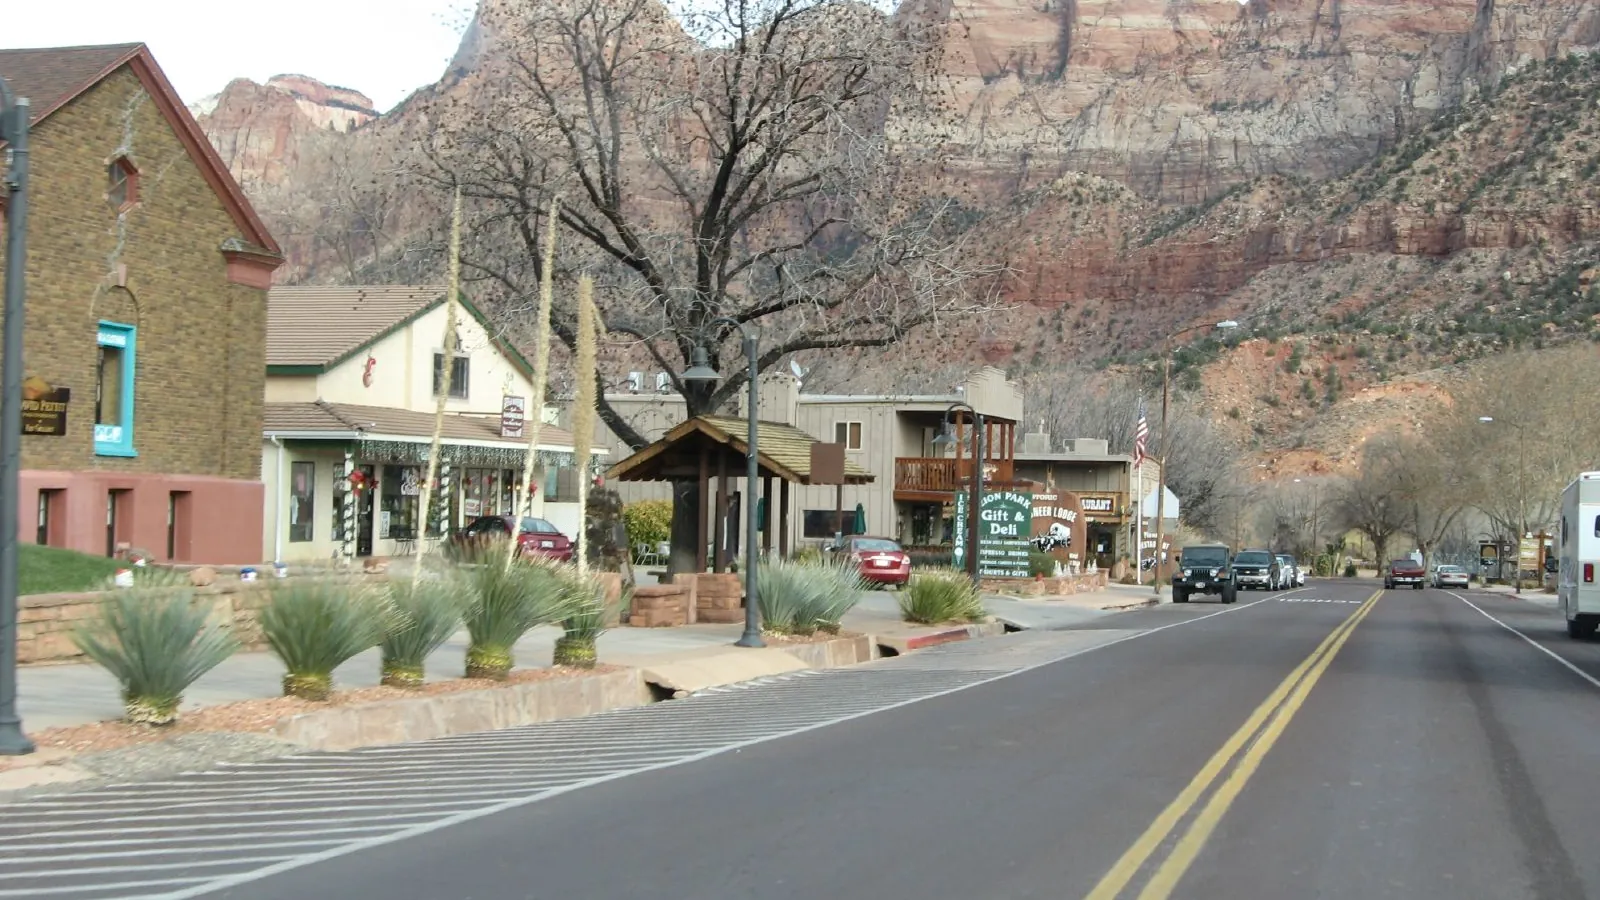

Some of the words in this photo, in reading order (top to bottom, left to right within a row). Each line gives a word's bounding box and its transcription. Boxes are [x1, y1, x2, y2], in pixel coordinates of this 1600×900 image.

[1005, 492, 1031, 509] PARK
[981, 509, 1009, 521] Gift
[1014, 511, 1025, 522] &
[1053, 507, 1077, 523] LODGE
[954, 515, 964, 547] CREAM
[990, 523, 1017, 536] Deli
